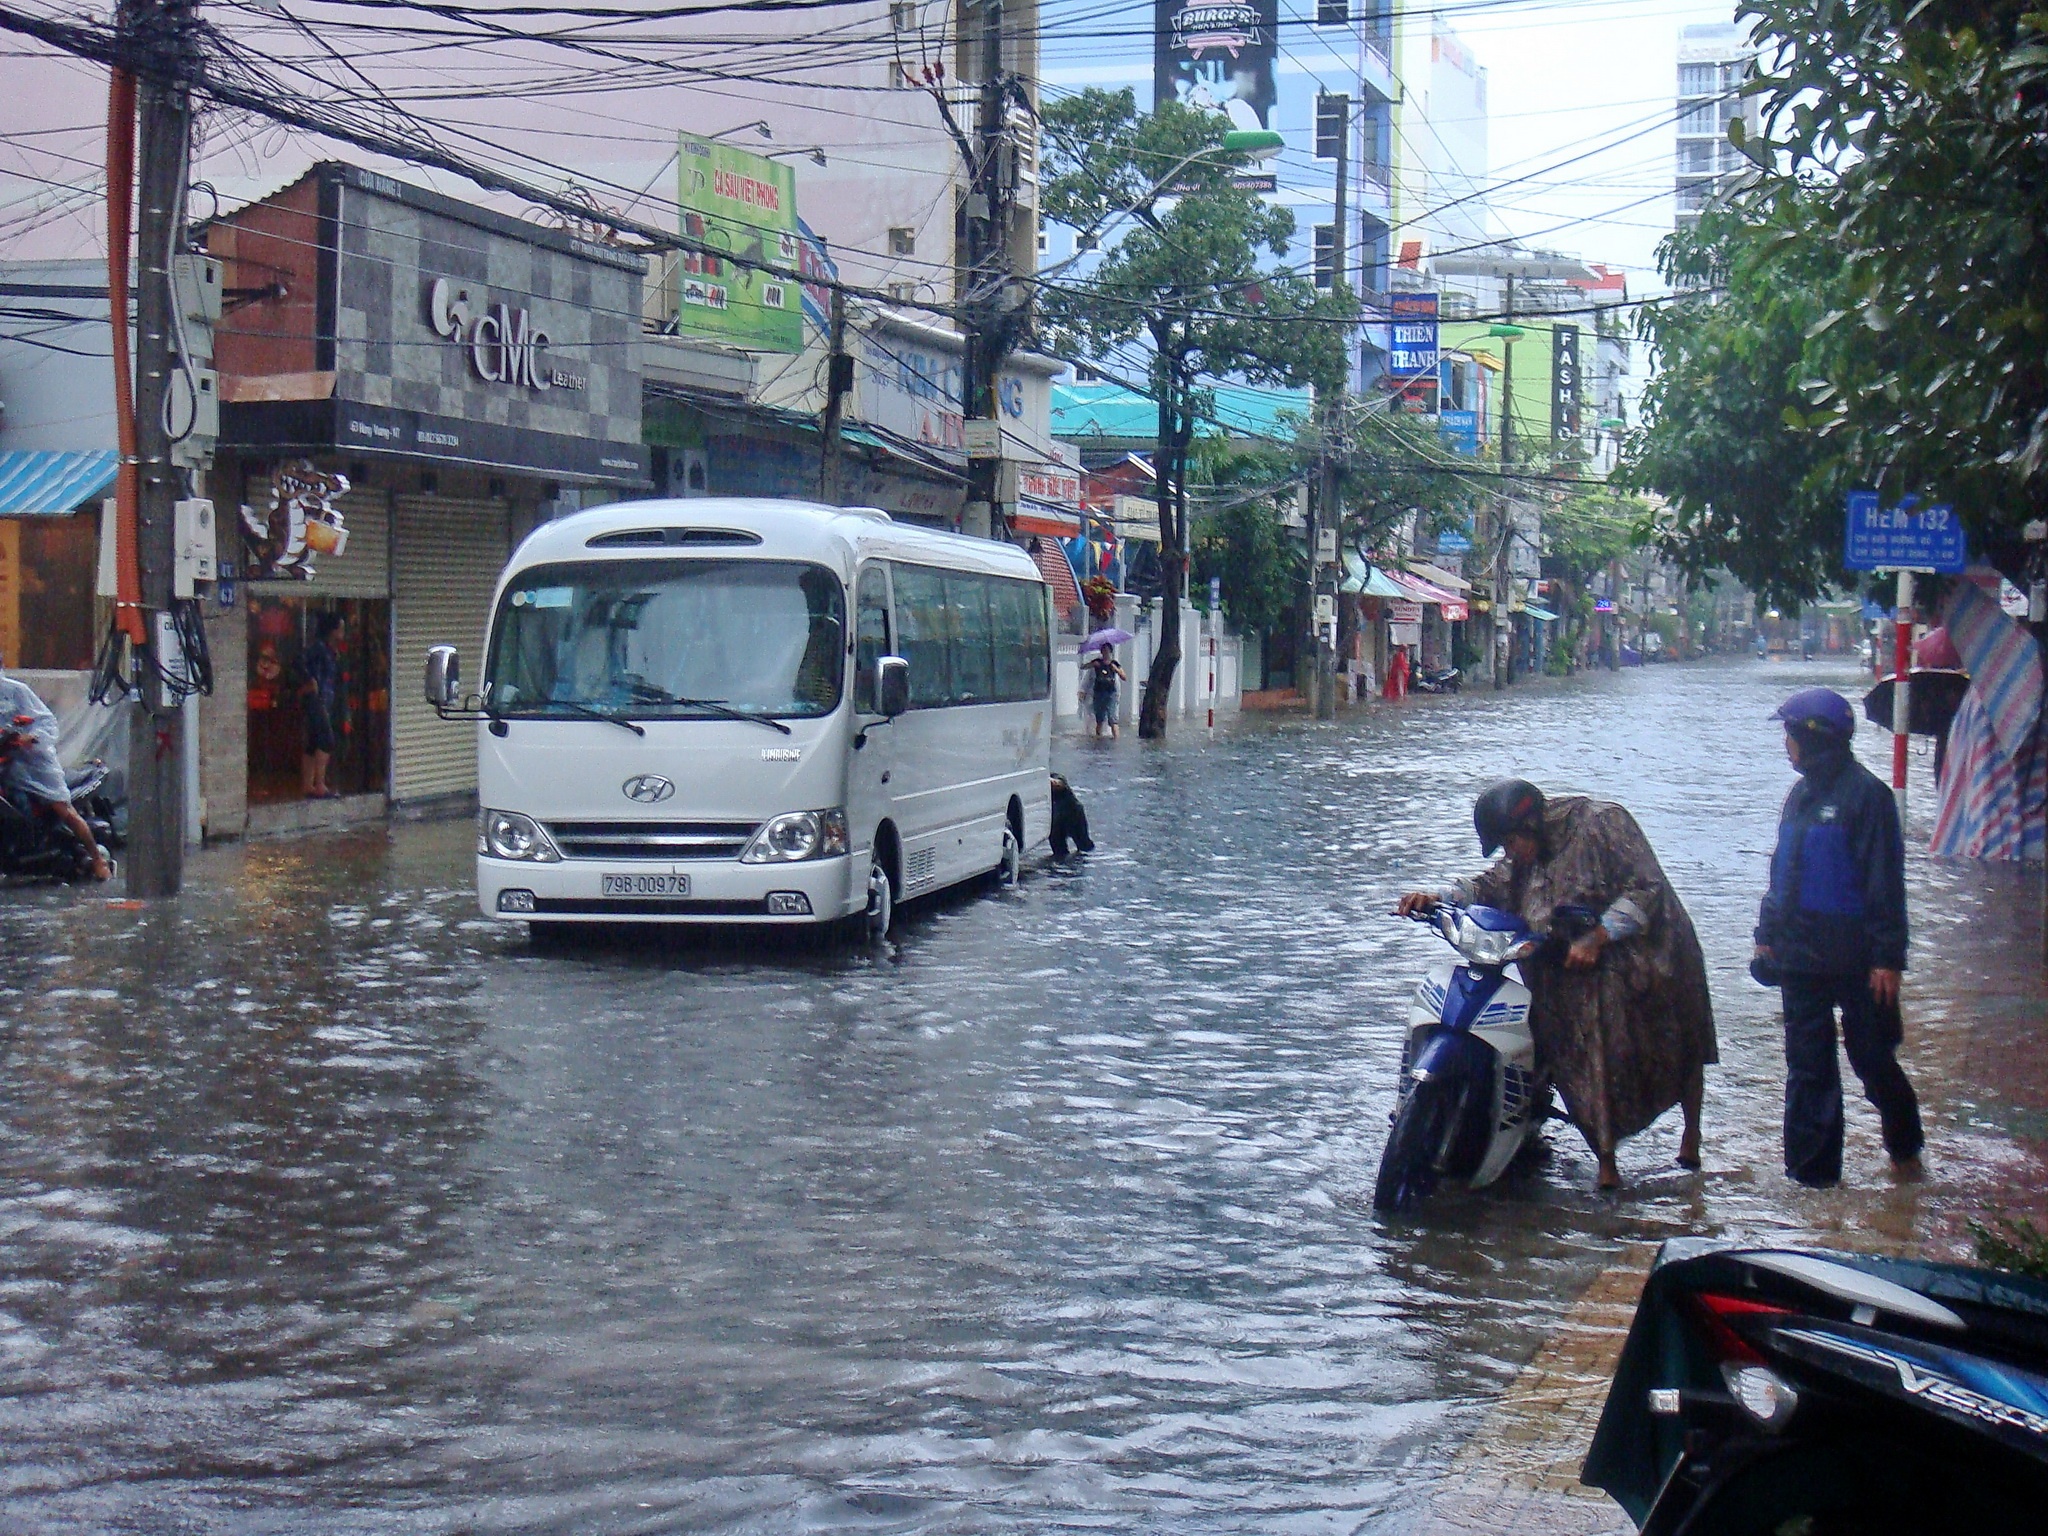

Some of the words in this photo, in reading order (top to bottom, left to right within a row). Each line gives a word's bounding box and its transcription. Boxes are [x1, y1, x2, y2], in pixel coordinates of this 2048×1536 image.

[474, 303, 551, 391] CMC
[552, 368, 587, 390] Leather
[944, 364, 1024, 418] CNG
[1556, 331, 1574, 461] FASHIO
[1919, 508, 1950, 532] 132
[604, 876, 687, 893] 79B-009.78
